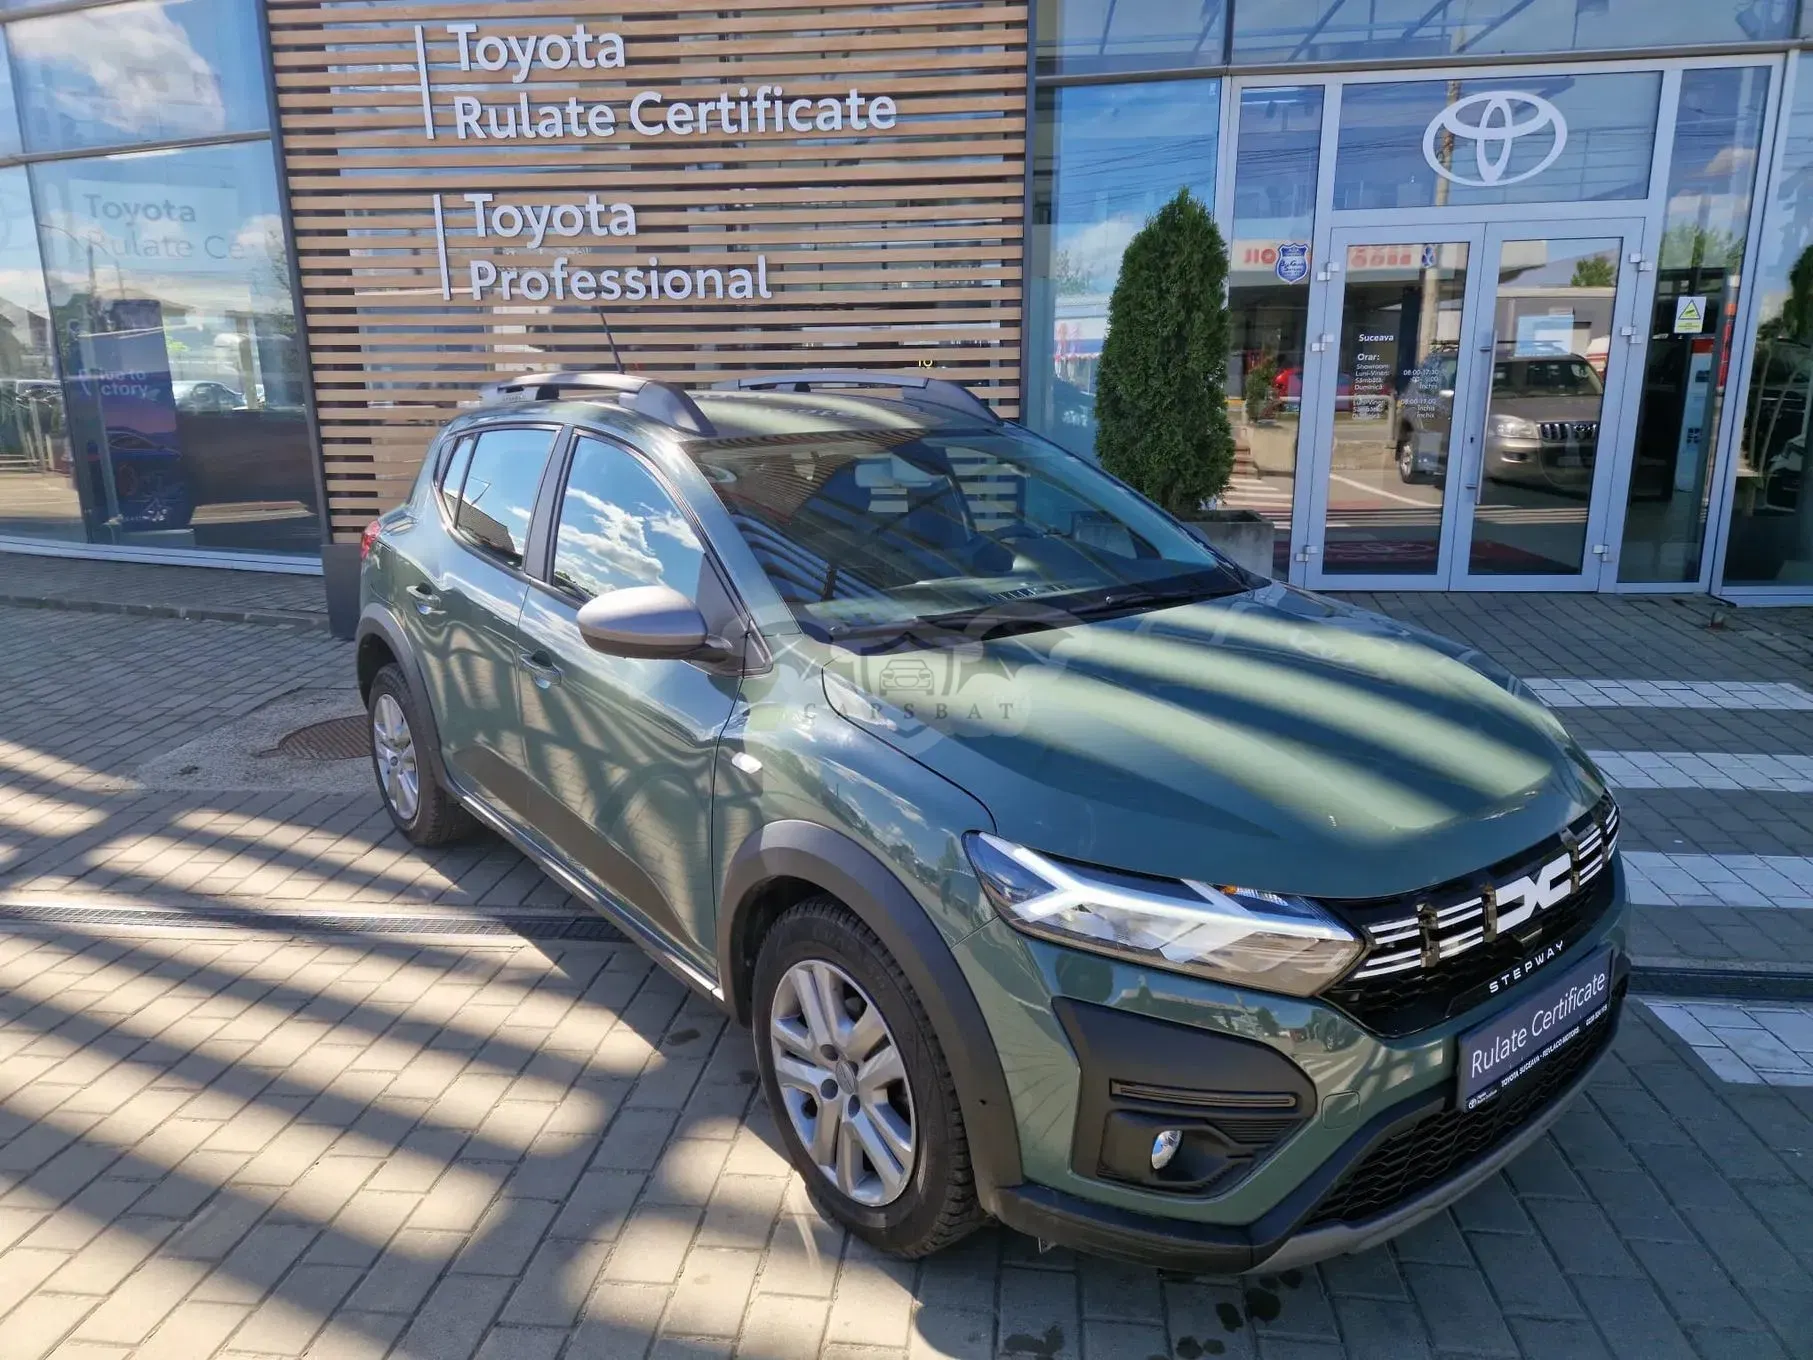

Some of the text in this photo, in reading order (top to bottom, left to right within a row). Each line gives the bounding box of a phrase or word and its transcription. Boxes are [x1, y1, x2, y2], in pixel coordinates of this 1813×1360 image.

[447, 23, 626, 84] Toyota
[453, 85, 897, 140] Rulate Certificate
[82, 193, 197, 227] Toyota
[464, 193, 637, 249] Toyota
[470, 255, 773, 301] Professional
[1357, 353, 1380, 361] Orar:
[1358, 333, 1394, 342] Suceava
[1489, 940, 1563, 993] STEPWAY
[1471, 973, 1606, 1078] Rulate Certificate
